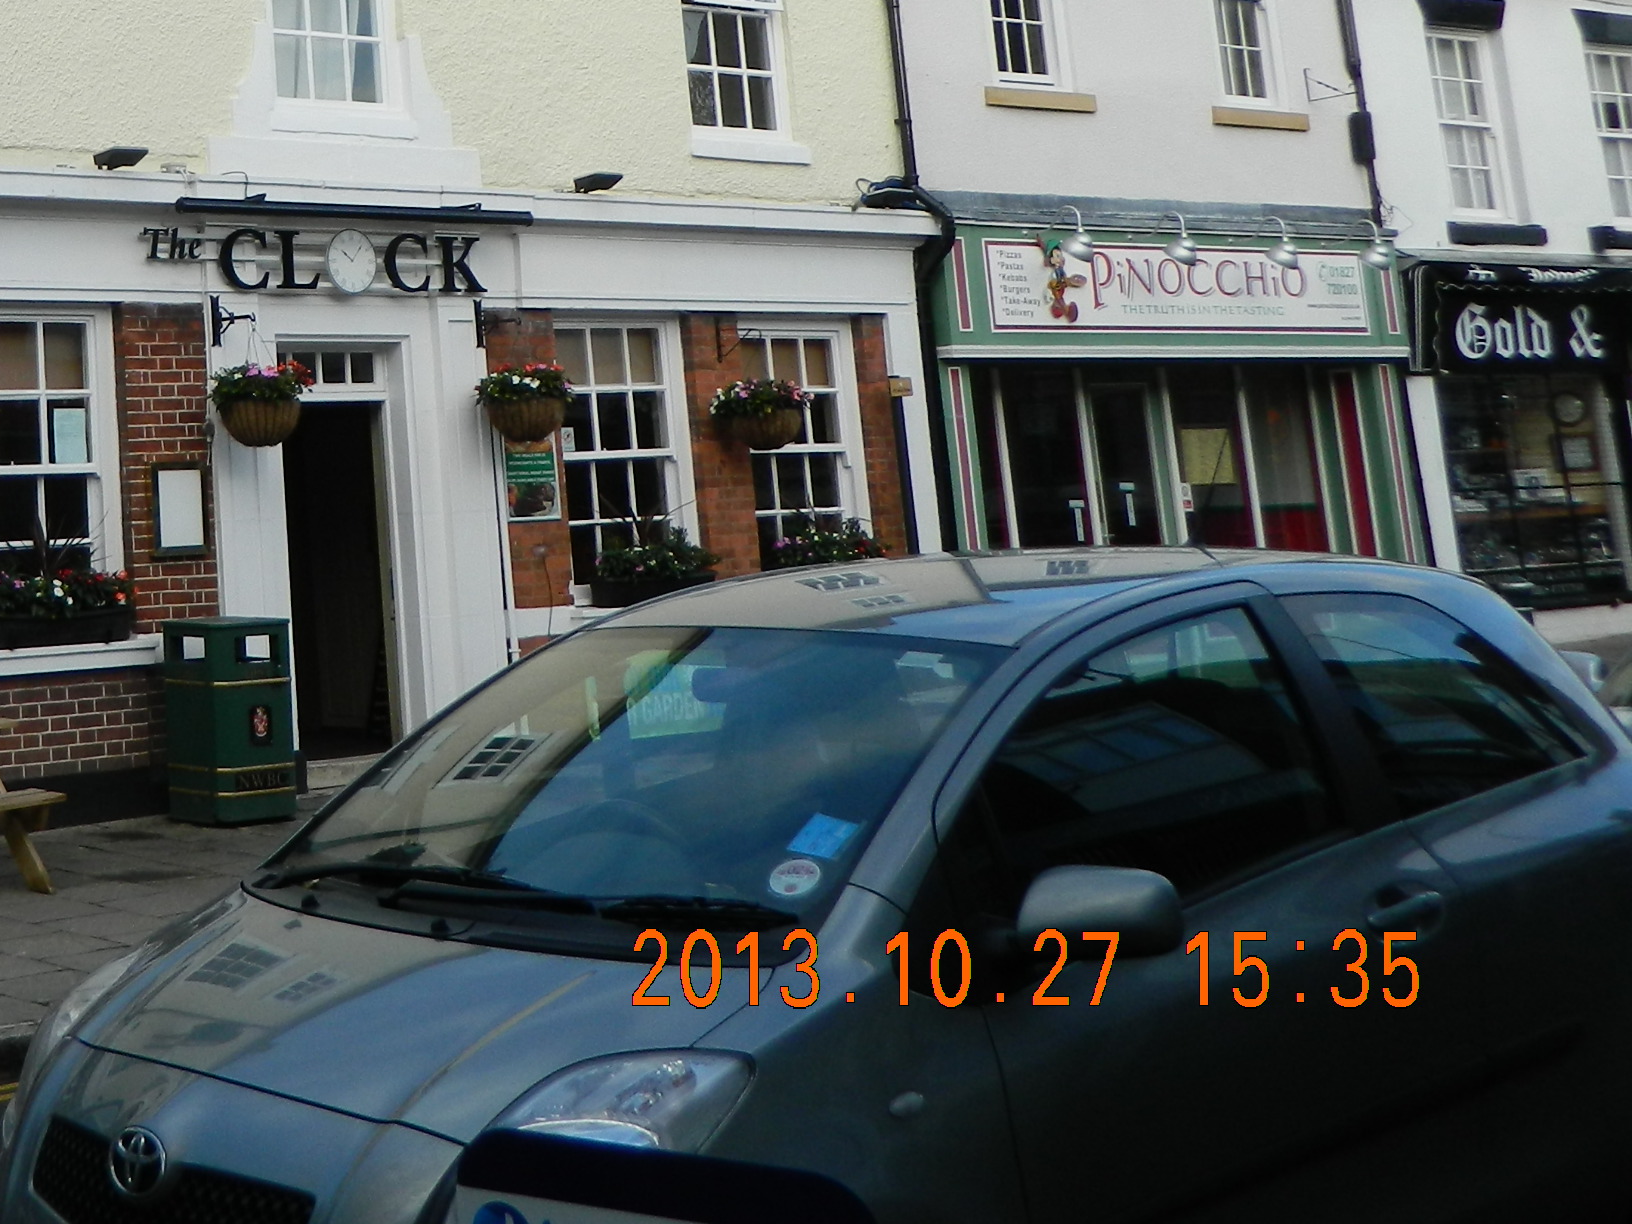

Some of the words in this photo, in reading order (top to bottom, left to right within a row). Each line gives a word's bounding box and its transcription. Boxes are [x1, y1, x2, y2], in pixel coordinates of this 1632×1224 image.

[143, 226, 202, 260] The
[1121, 304, 1144, 314] THE
[1145, 304, 1184, 314] TRUTH
[1212, 305, 1235, 315] THE
[1236, 305, 1285, 316] TASTING
[1455, 302, 1553, 359] Gold
[1569, 304, 1604, 358] &
[238, 771, 289, 789] NWBC
